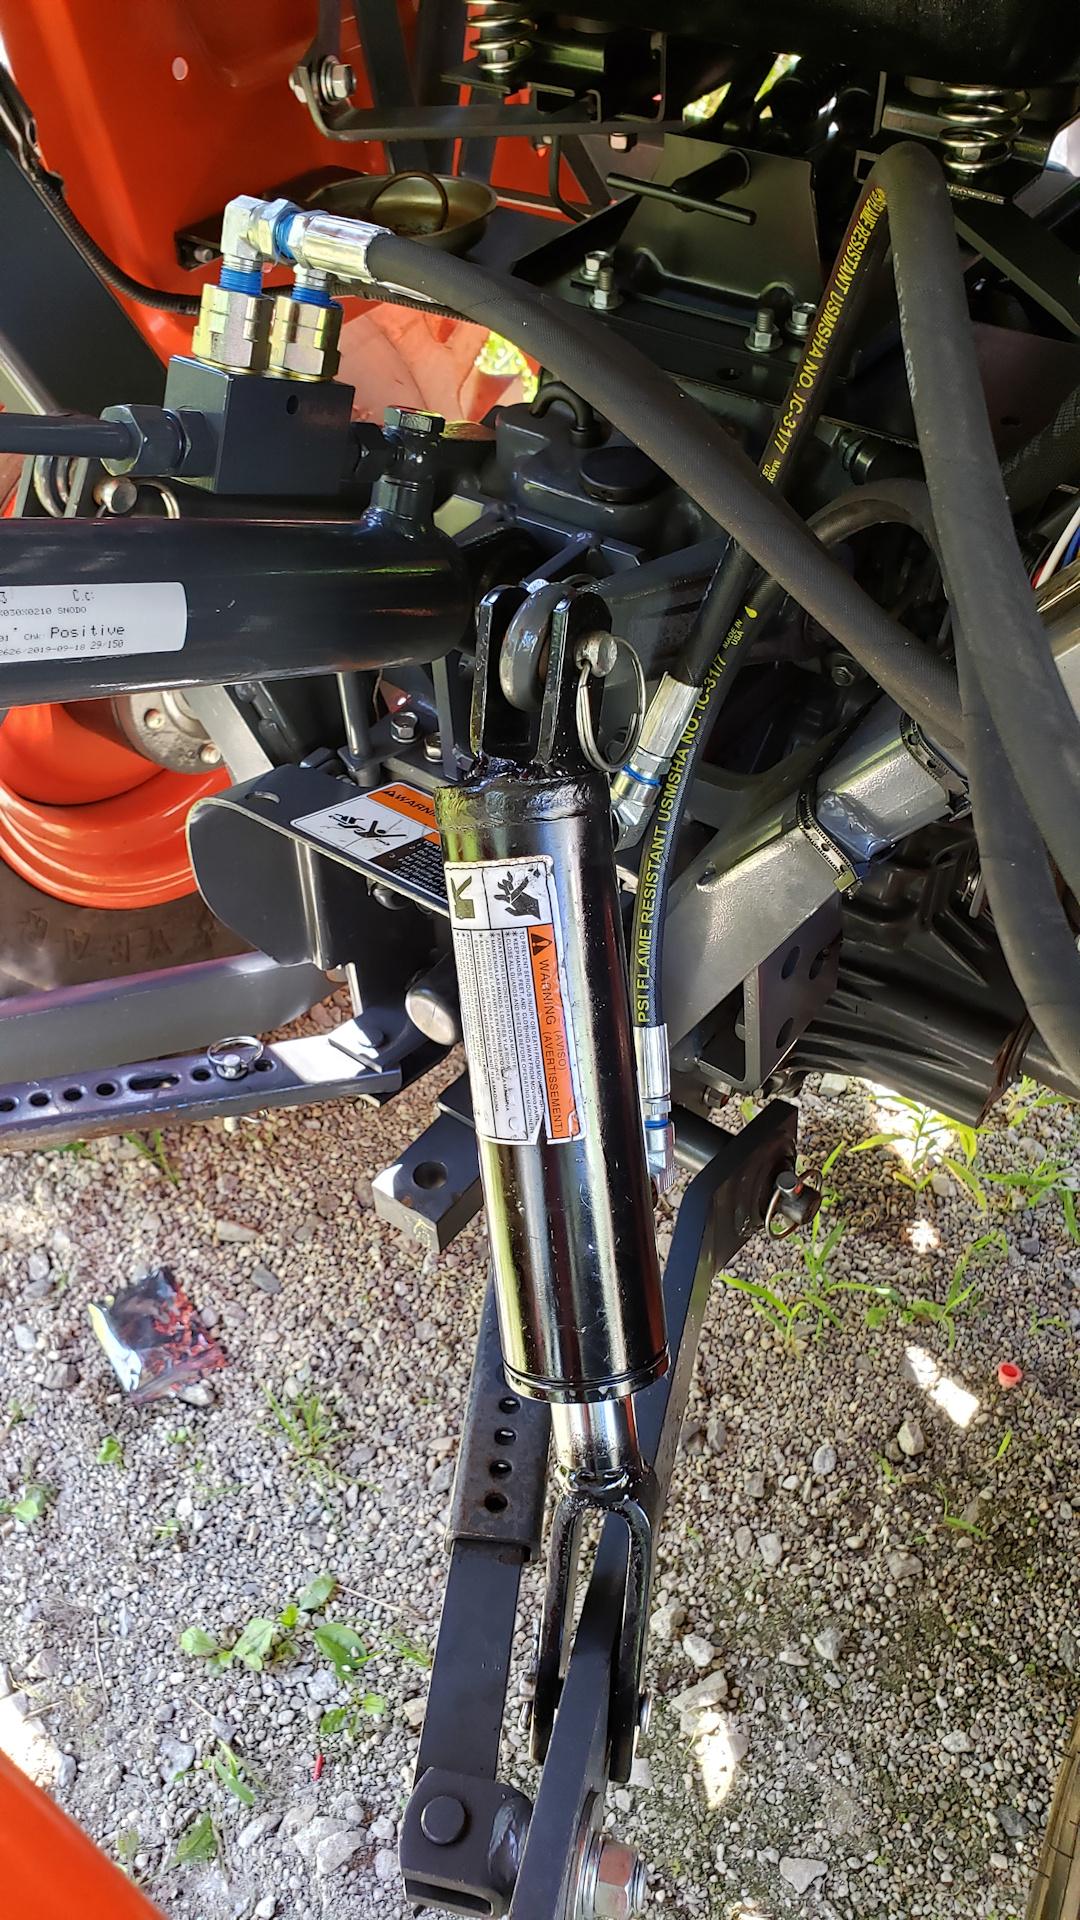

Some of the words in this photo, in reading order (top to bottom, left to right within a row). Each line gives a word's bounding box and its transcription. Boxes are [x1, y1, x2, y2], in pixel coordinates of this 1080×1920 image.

[835, 220, 871, 295] RESISTANT
[808, 290, 844, 358] USMSHA
[796, 358, 819, 388] NO.
[774, 392, 806, 454] IC-31/7
[50, 624, 125, 639] Positive
[90, 640, 124, 650] 29/150
[722, 627, 738, 649] MADE
[734, 618, 743, 630] IN
[731, 630, 745, 647] USA
[697, 653, 727, 711] IC-31/7
[681, 715, 702, 745] NO.
[657, 748, 689, 822] USMSHA
[640, 825, 667, 924] RESISTANT
[518, 932, 525, 940] TO
[519, 940, 528, 969] PREVENT
[636, 928, 653, 990] FLAME
[523, 971, 532, 997] SERIOUS
[537, 958, 557, 1025] WARNING
[526, 998, 534, 1019] INJURY
[637, 995, 650, 1023] PSI
[514, 1011, 522, 1037] SHIELDS
[521, 1012, 530, 1043] CLOTHING
[529, 1020, 536, 1029] OR
[517, 1038, 525, 1063] BEFORE
[525, 1044, 533, 1061] AWAY
[530, 1030, 538, 1051] DEATH
[553, 1029, 567, 1070] (AVISO)
[521, 1063, 530, 1098] OPERATING
[529, 1080, 537, 1105] MOVING
[541, 1030, 564, 1133] (AVERTISSEMENT)
